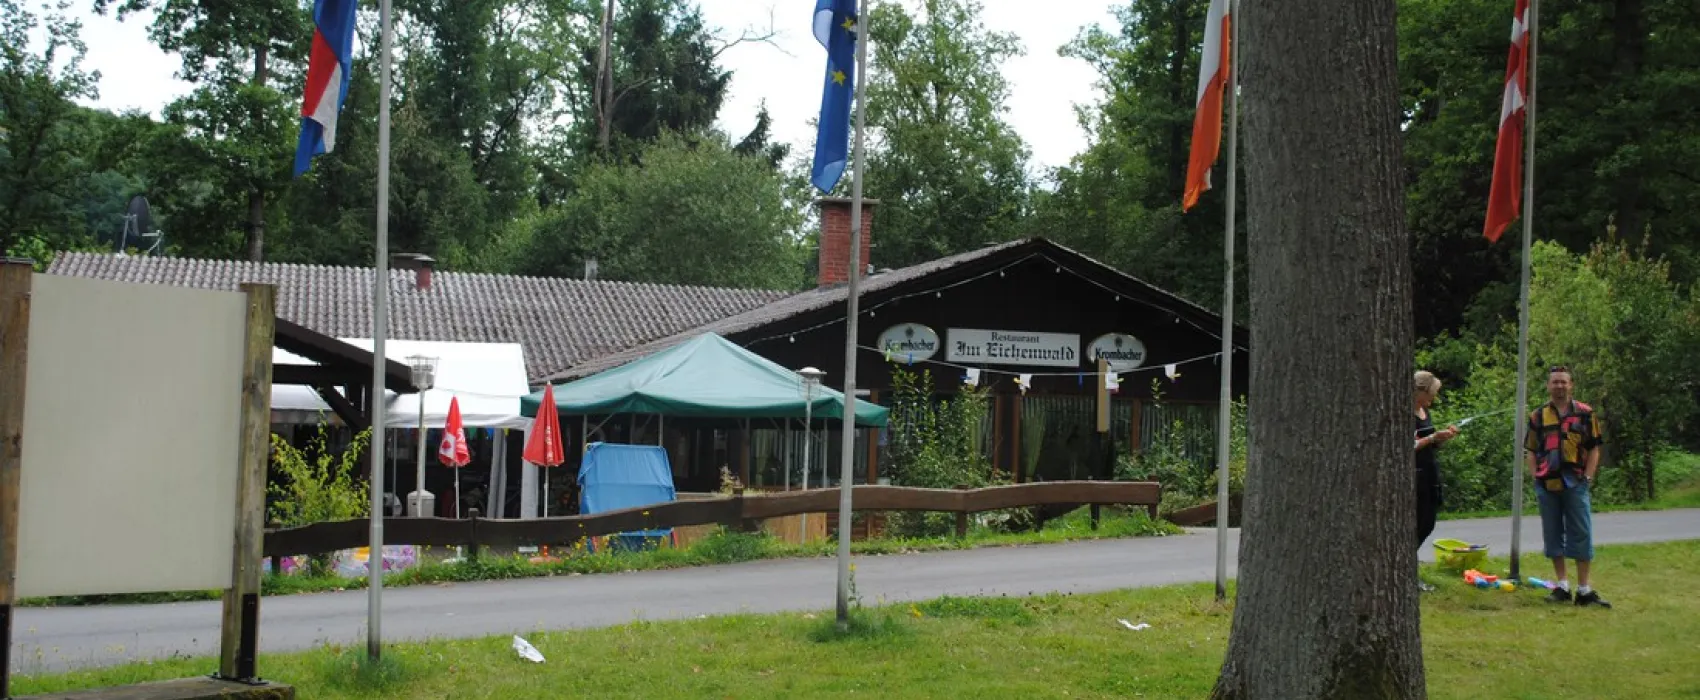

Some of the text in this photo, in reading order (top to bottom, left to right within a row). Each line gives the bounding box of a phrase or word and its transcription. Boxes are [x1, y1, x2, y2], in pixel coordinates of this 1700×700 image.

[991, 331, 1040, 343] Restaurant
[954, 340, 1075, 361] Im Eichenwald
[1095, 347, 1142, 361] Krombacher
